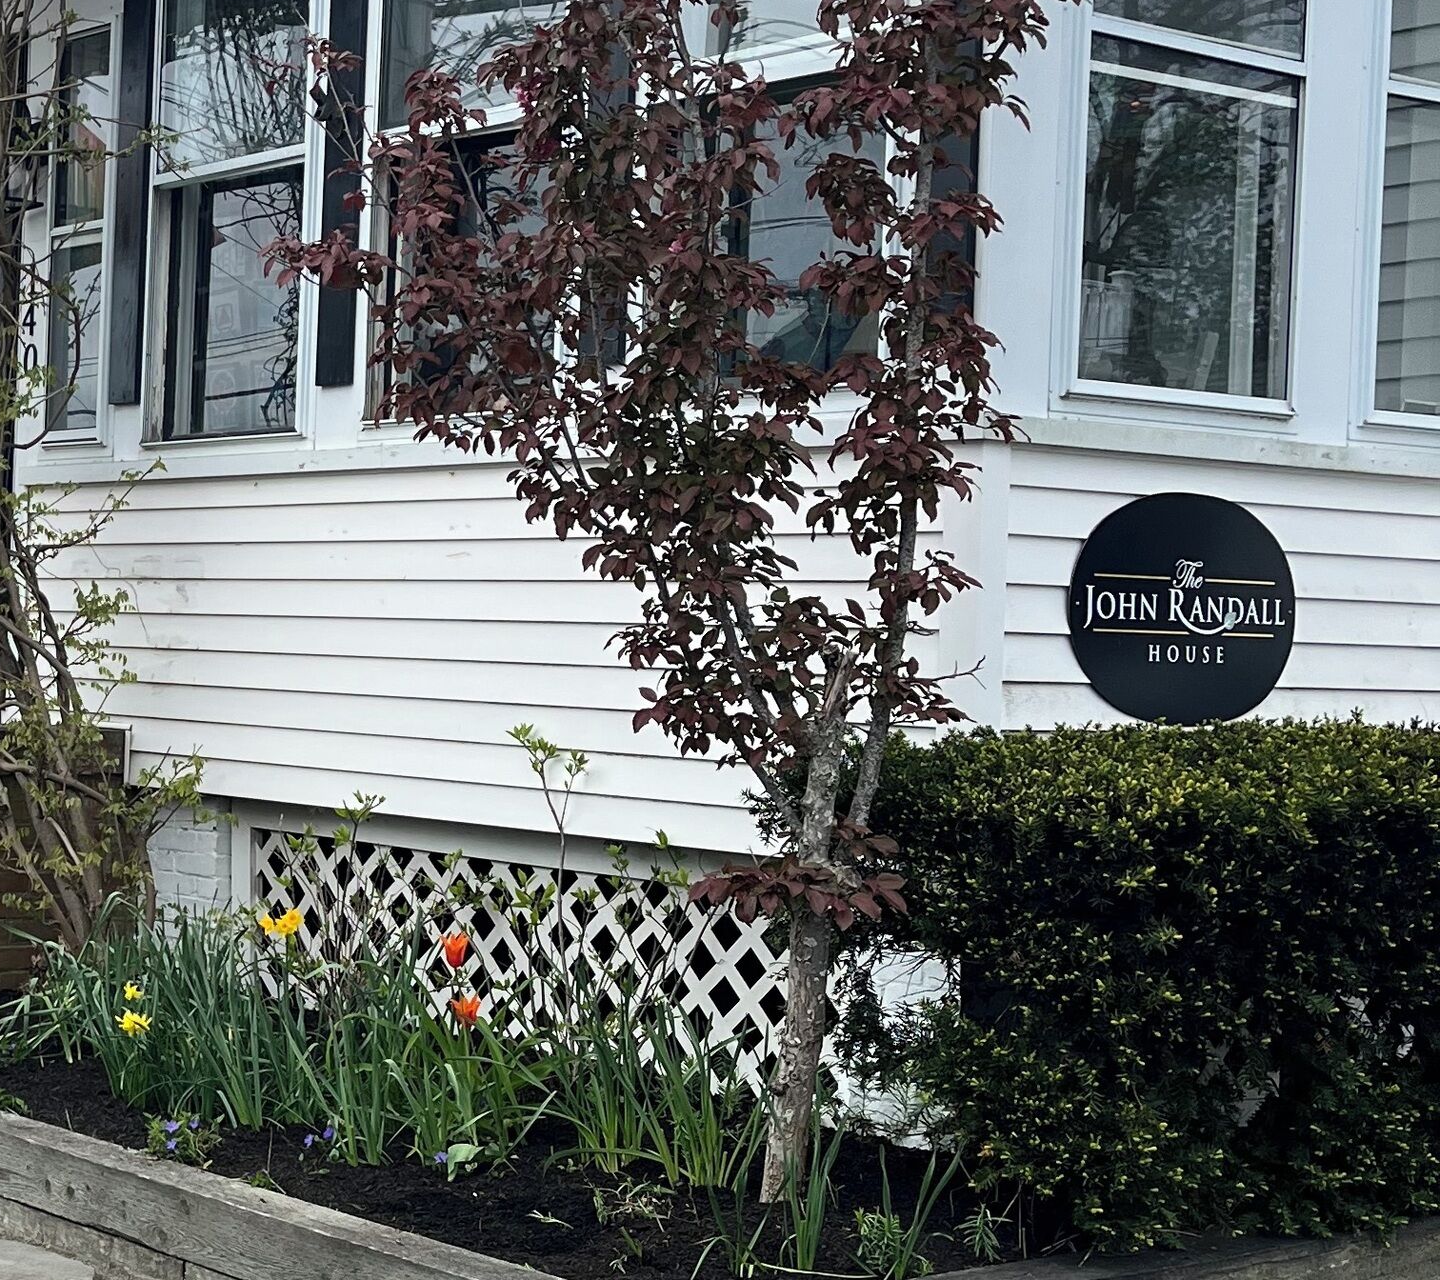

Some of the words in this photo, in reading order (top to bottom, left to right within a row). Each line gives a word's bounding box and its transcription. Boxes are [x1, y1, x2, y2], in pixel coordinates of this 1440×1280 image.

[1172, 559, 1204, 589] The
[1083, 584, 1158, 629] JOHN
[1167, 587, 1286, 635] RANDALL
[1148, 644, 1225, 664] HOUSE
